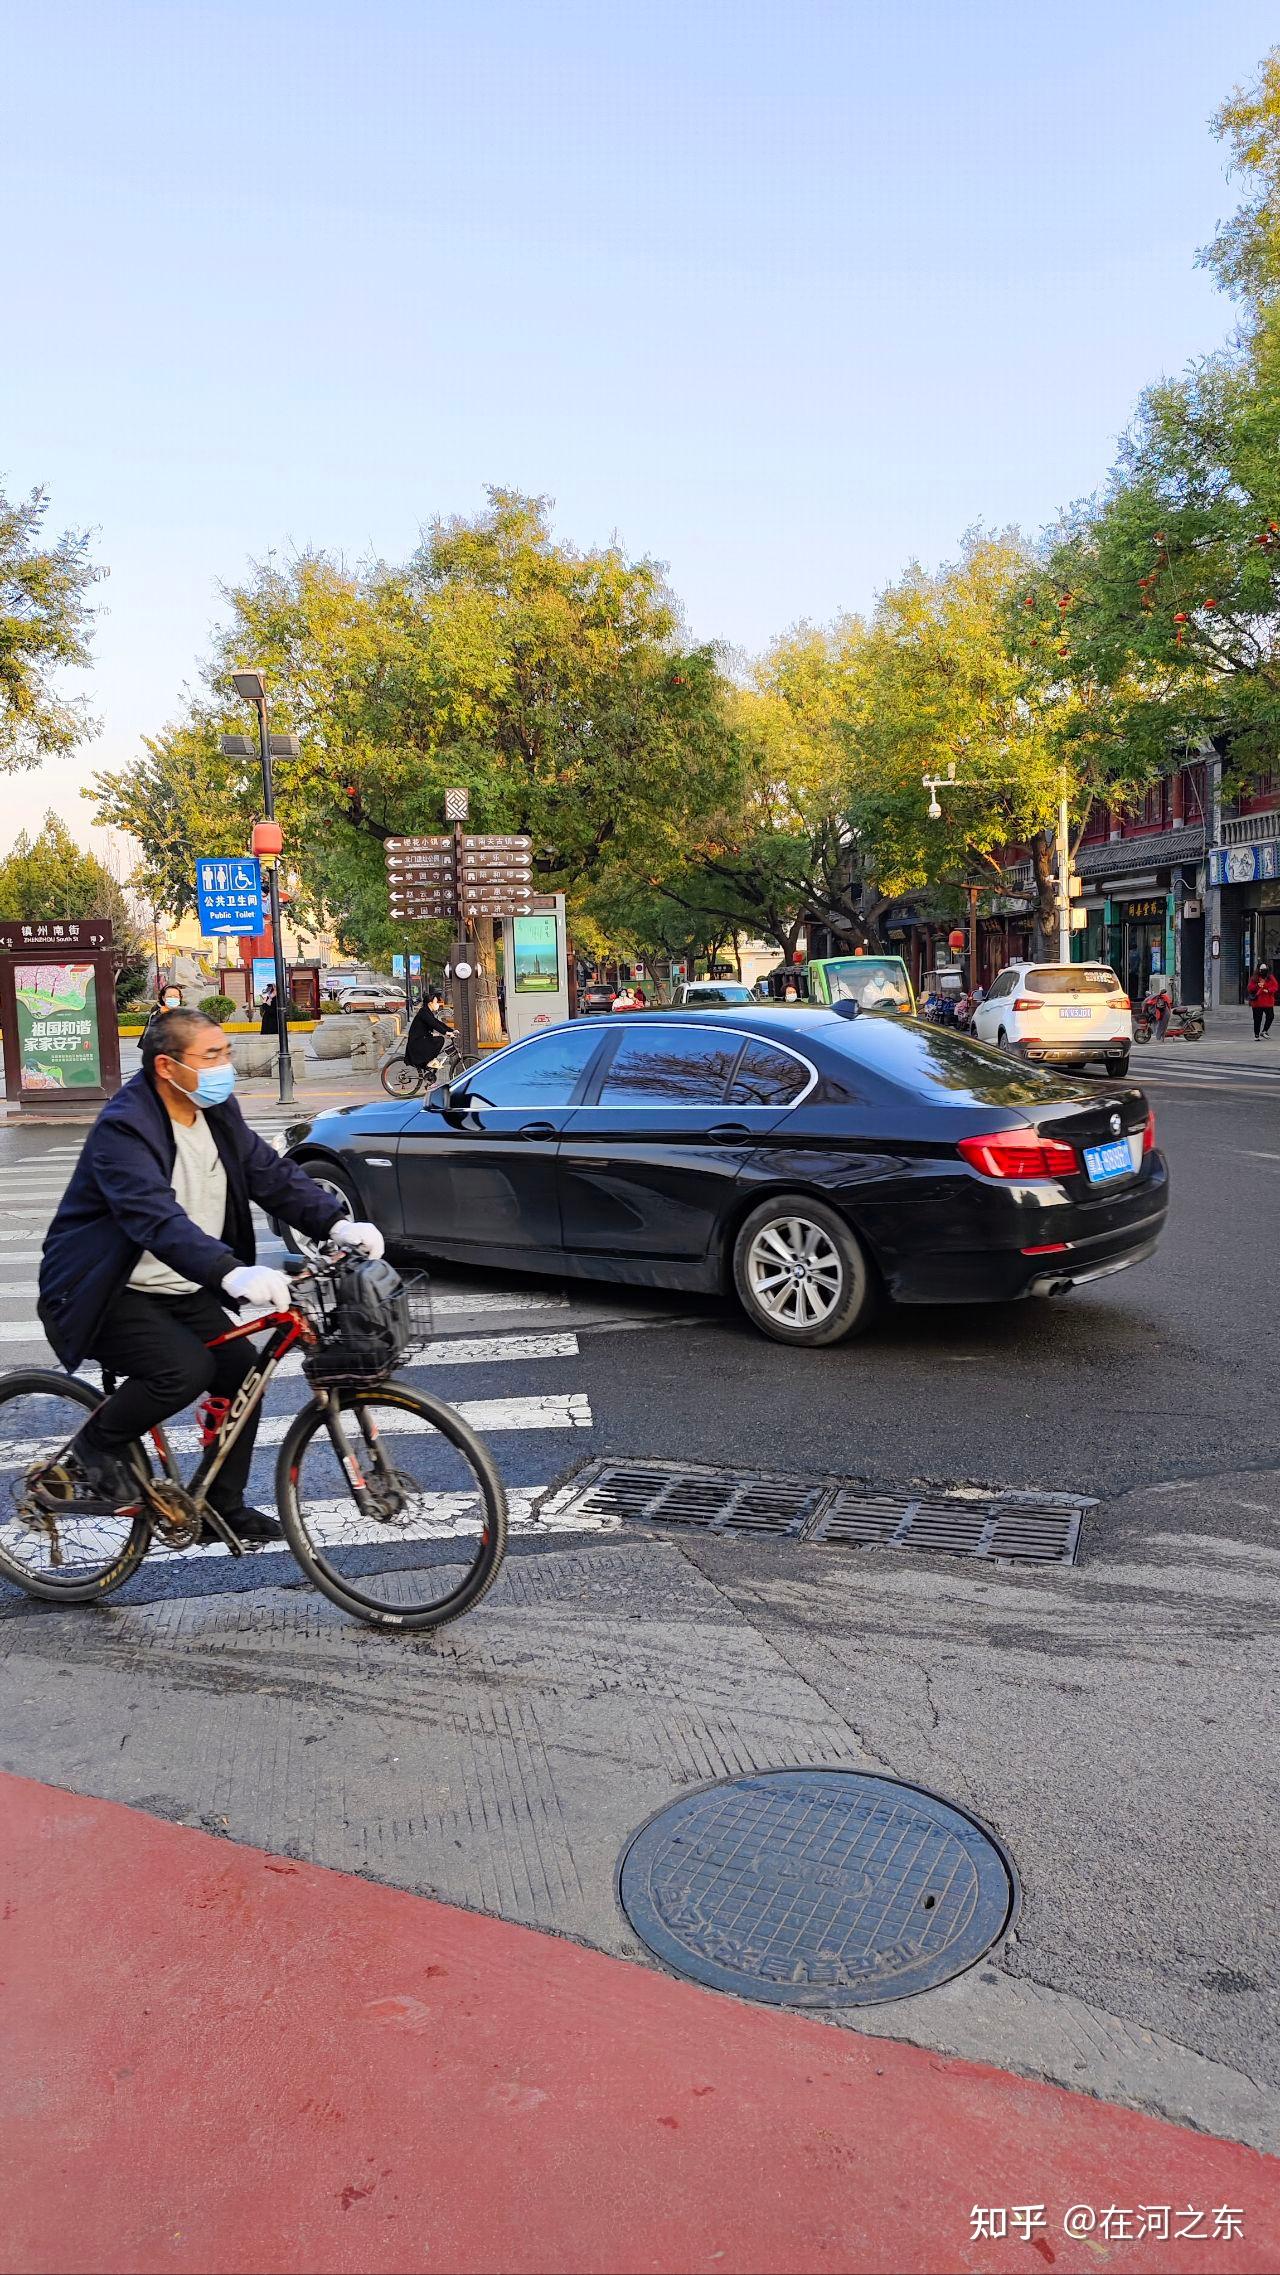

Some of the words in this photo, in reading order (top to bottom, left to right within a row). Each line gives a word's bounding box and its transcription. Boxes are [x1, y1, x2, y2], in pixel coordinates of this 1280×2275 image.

[479, 853, 514, 862] 长乐门
[204, 894, 258, 907] 公共卫生间
[210, 911, 232, 919] Public
[235, 911, 256, 919] Toilet
[21, 925, 80, 937] 镇州南街
[32, 1020, 92, 1037] 祖国和谐
[24, 1036, 81, 1052] 家家安宁
